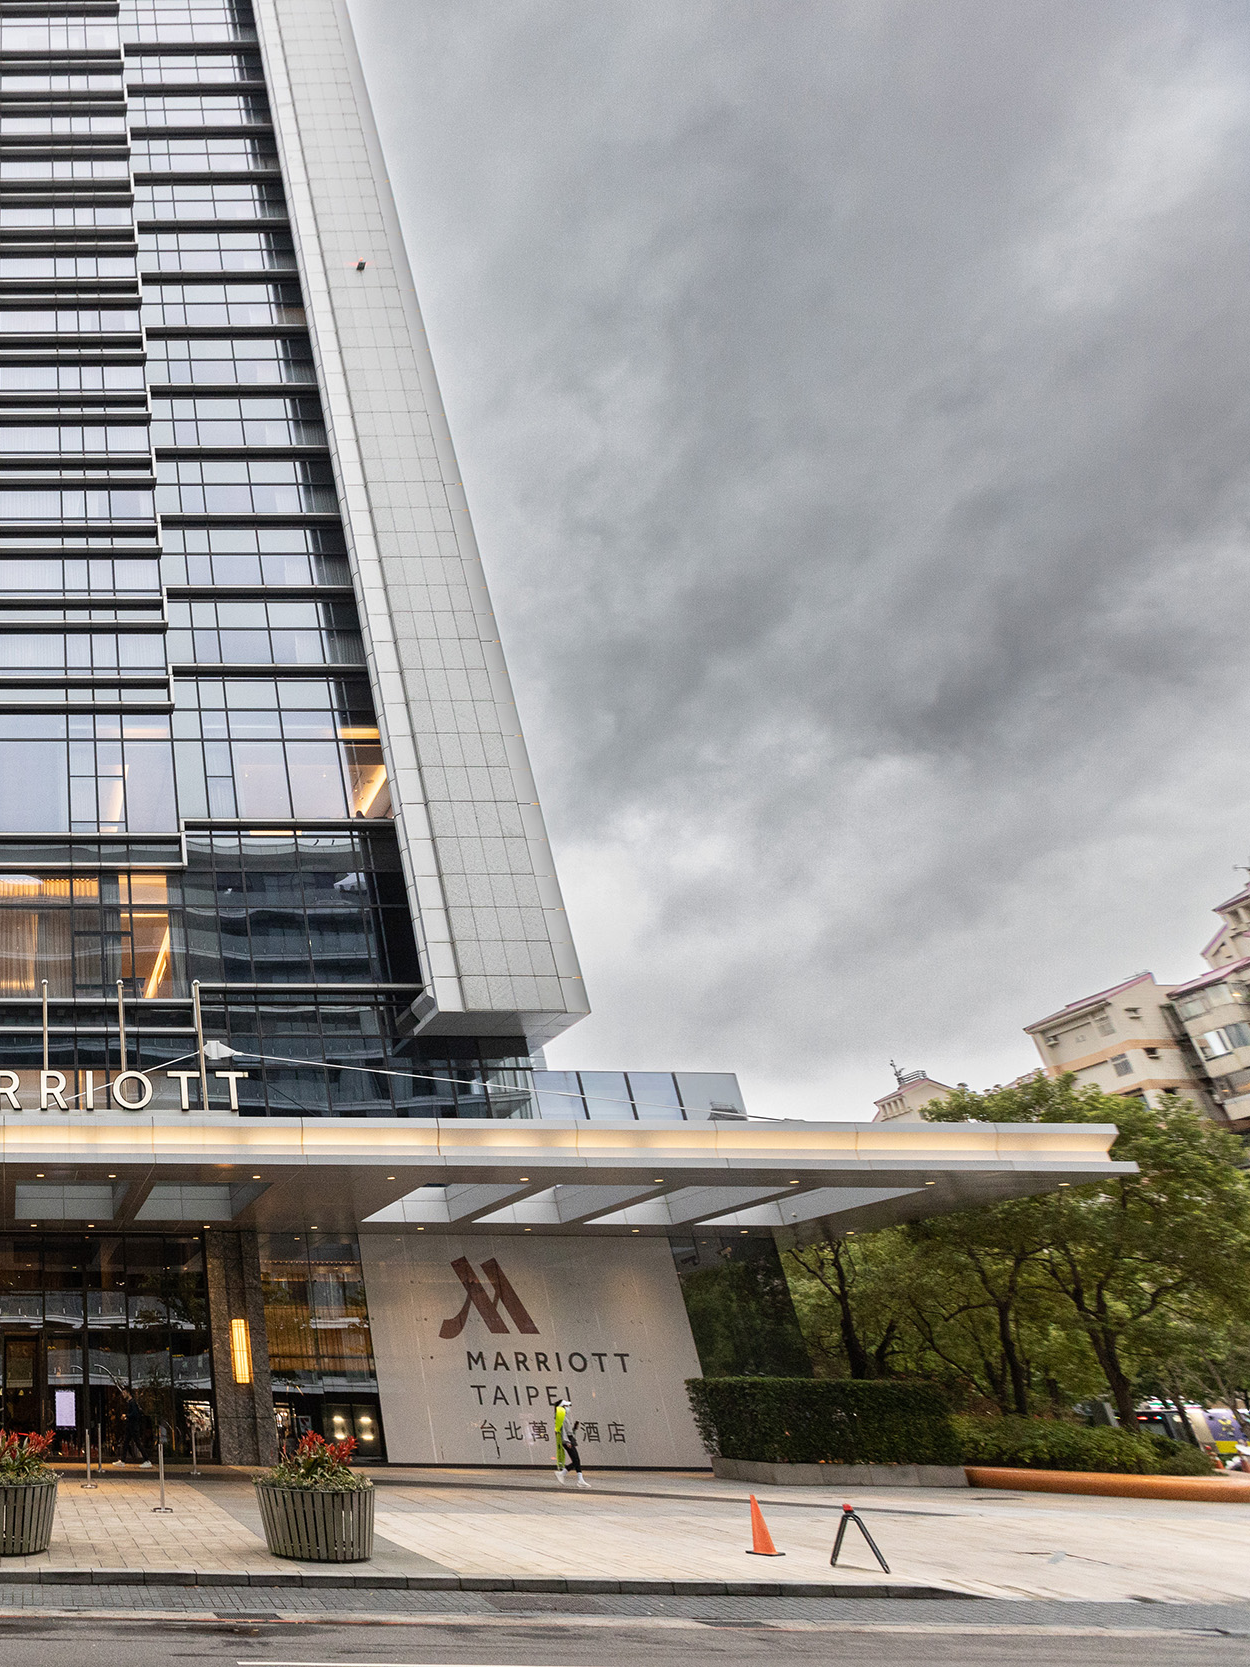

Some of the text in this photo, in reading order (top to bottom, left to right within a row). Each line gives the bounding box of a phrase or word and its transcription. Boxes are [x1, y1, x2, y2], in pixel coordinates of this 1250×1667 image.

[466, 1351, 630, 1373] MARRIOTT
[470, 1385, 572, 1407] TAIPEI
[480, 1419, 627, 1444] 台北萬酒店
